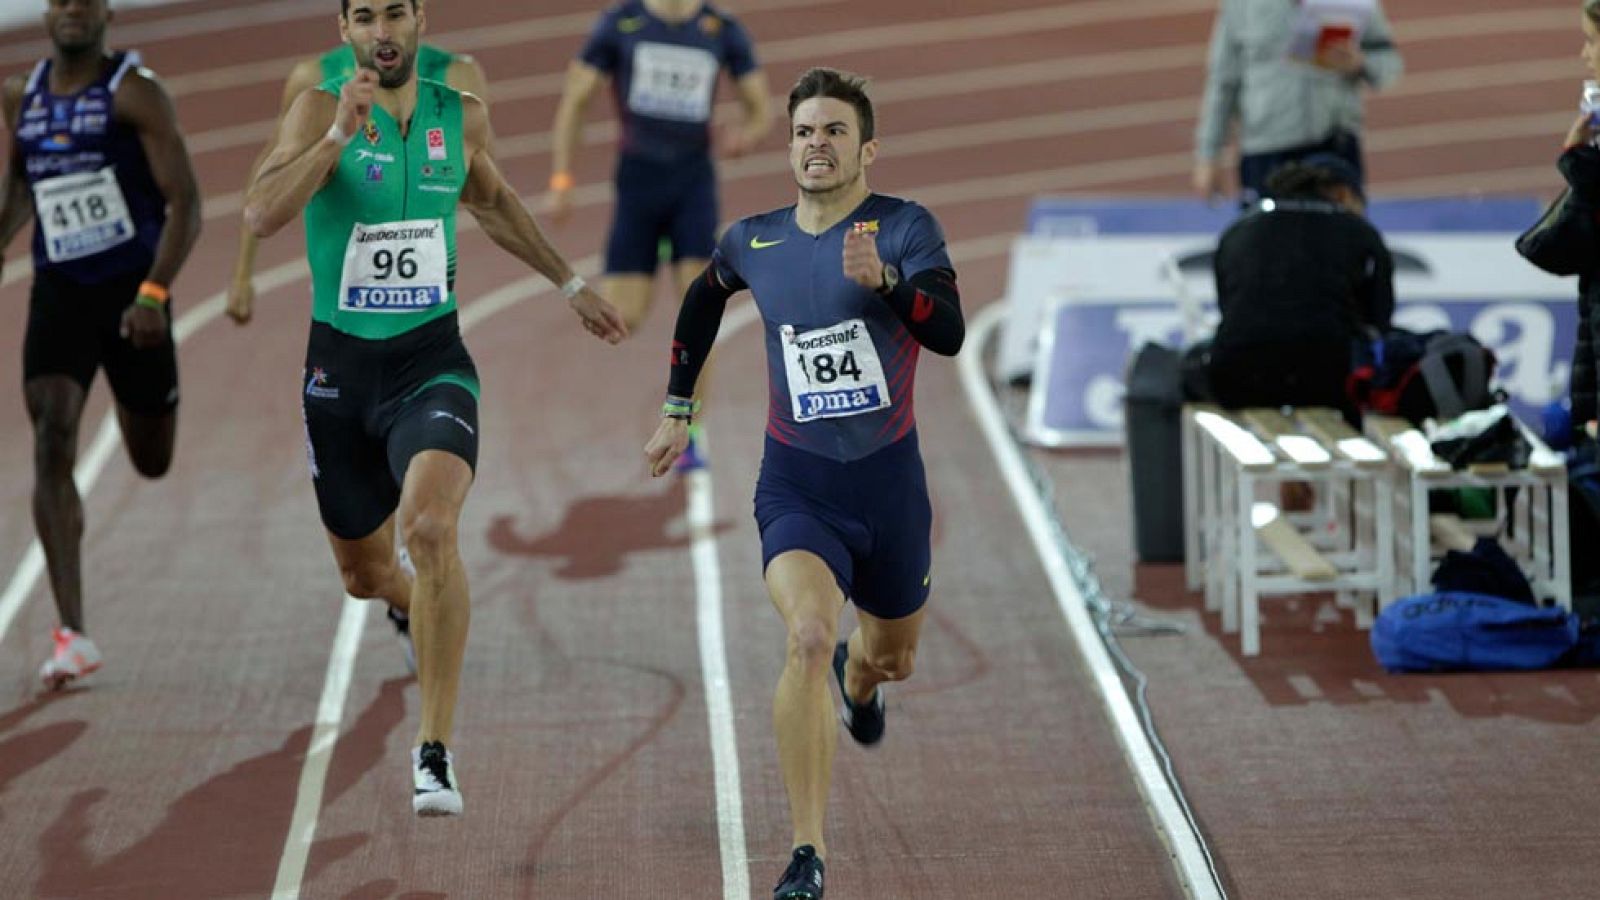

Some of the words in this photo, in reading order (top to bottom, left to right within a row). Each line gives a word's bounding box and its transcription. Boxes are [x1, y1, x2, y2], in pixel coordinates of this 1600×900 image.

[51, 194, 108, 228] 418
[372, 247, 418, 280] 96
[797, 350, 863, 384] 184
